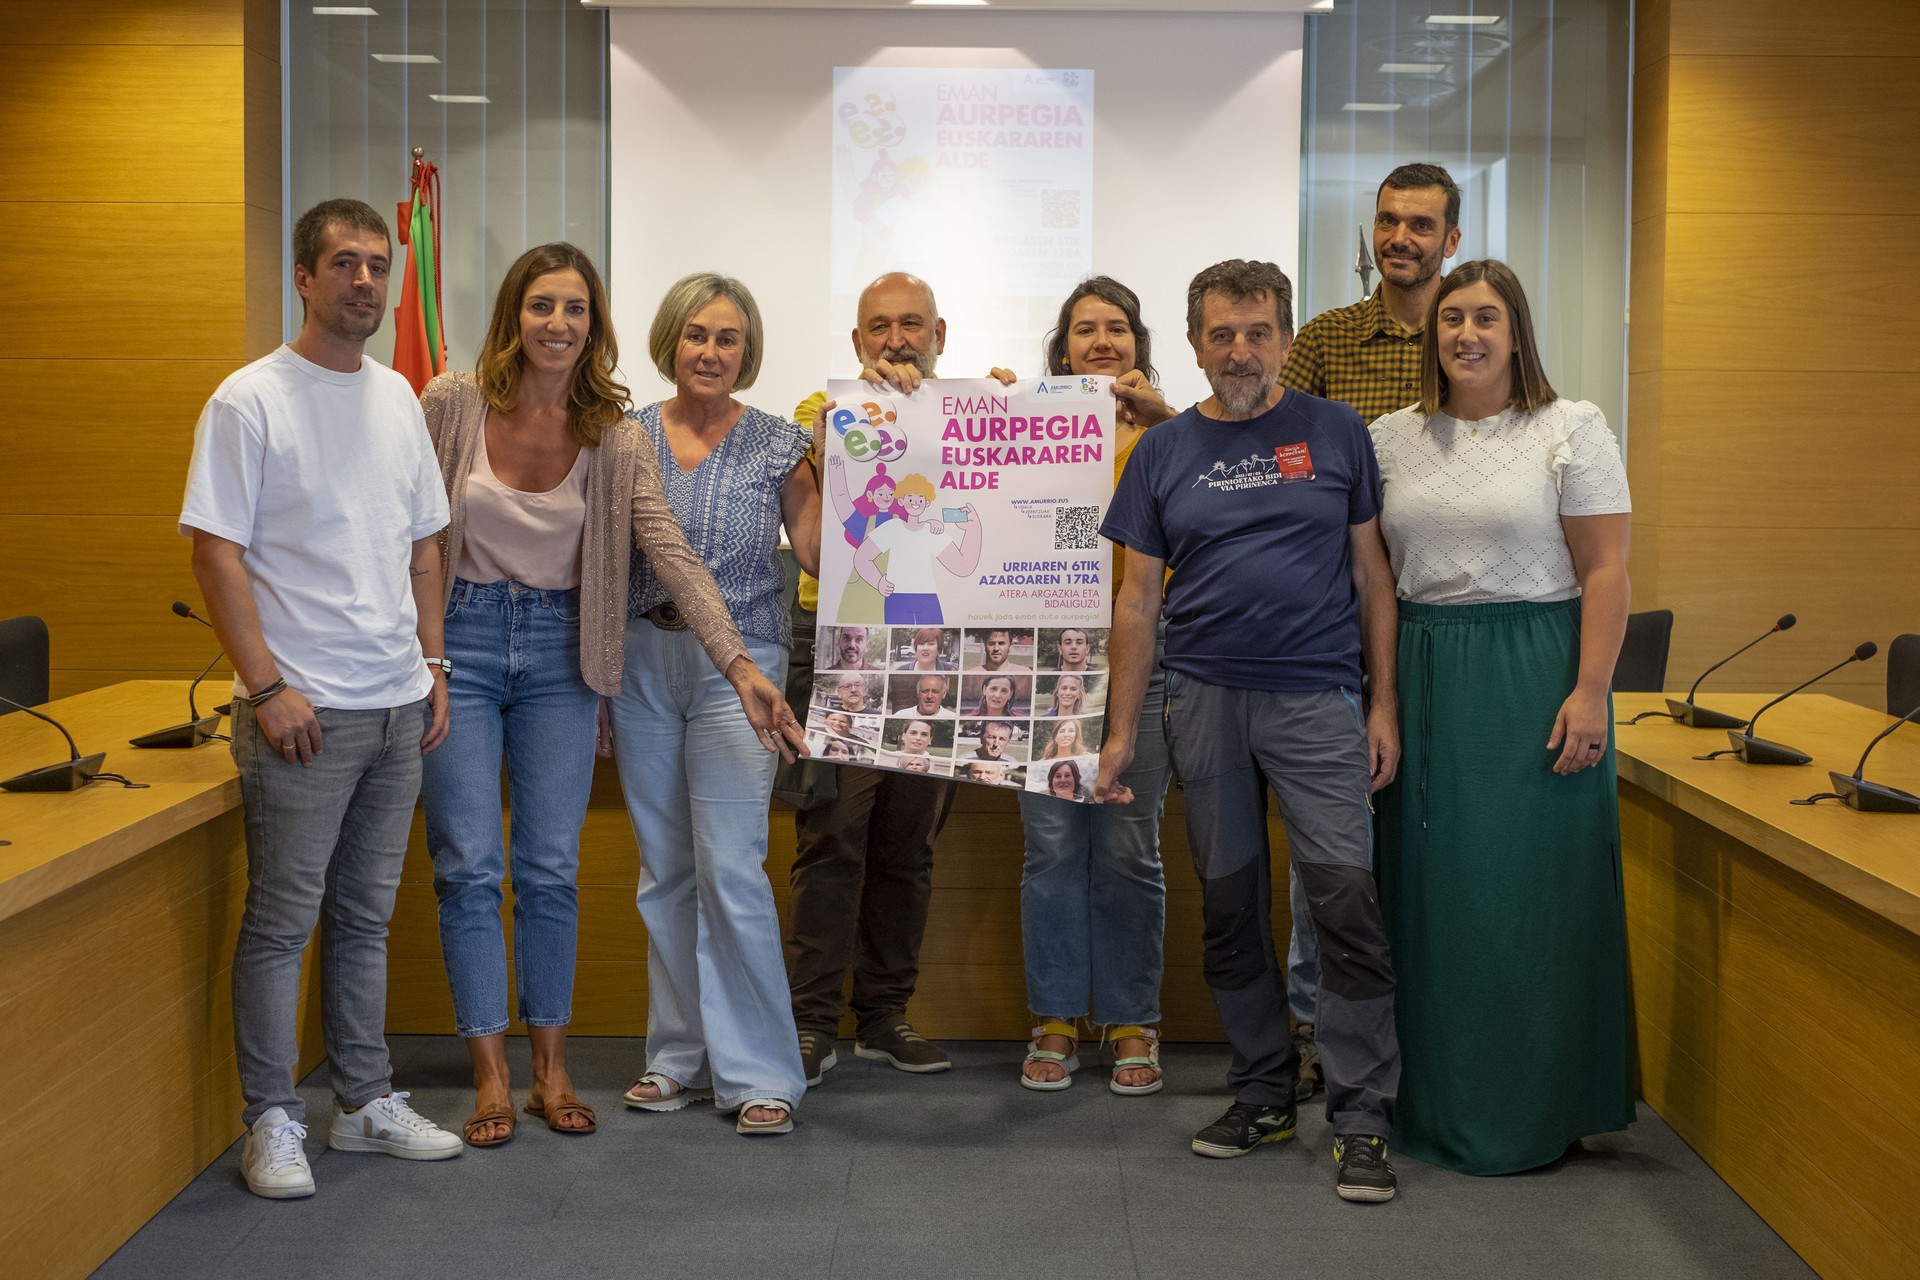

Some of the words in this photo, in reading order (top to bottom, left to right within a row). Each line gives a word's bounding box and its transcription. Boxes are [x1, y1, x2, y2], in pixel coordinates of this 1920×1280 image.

[936, 84, 998, 101] EMAN
[936, 103, 1084, 127] AURPEGIA
[936, 130, 1083, 148] EUSKARAREN
[936, 151, 989, 169] ALDE
[942, 395, 1008, 415] EMAN
[941, 414, 1103, 443] AURPEGIA
[941, 443, 1103, 467] EUSKARAREN
[939, 470, 999, 490] ALDE
[1235, 480, 1278, 490] PIRINENCA
[1003, 561, 1067, 572] URRIAREN
[1071, 560, 1100, 572] 6TIK
[979, 574, 1061, 586] AZAROAREN
[1066, 574, 1100, 585] 17RA
[999, 589, 1028, 598] ATERA
[1031, 589, 1080, 598] ARGAZKIA
[1082, 589, 1100, 598] ETA
[1044, 599, 1100, 608] BIDALIGUZU
[995, 613, 1012, 622] jada
[1038, 612, 1059, 620] dute
